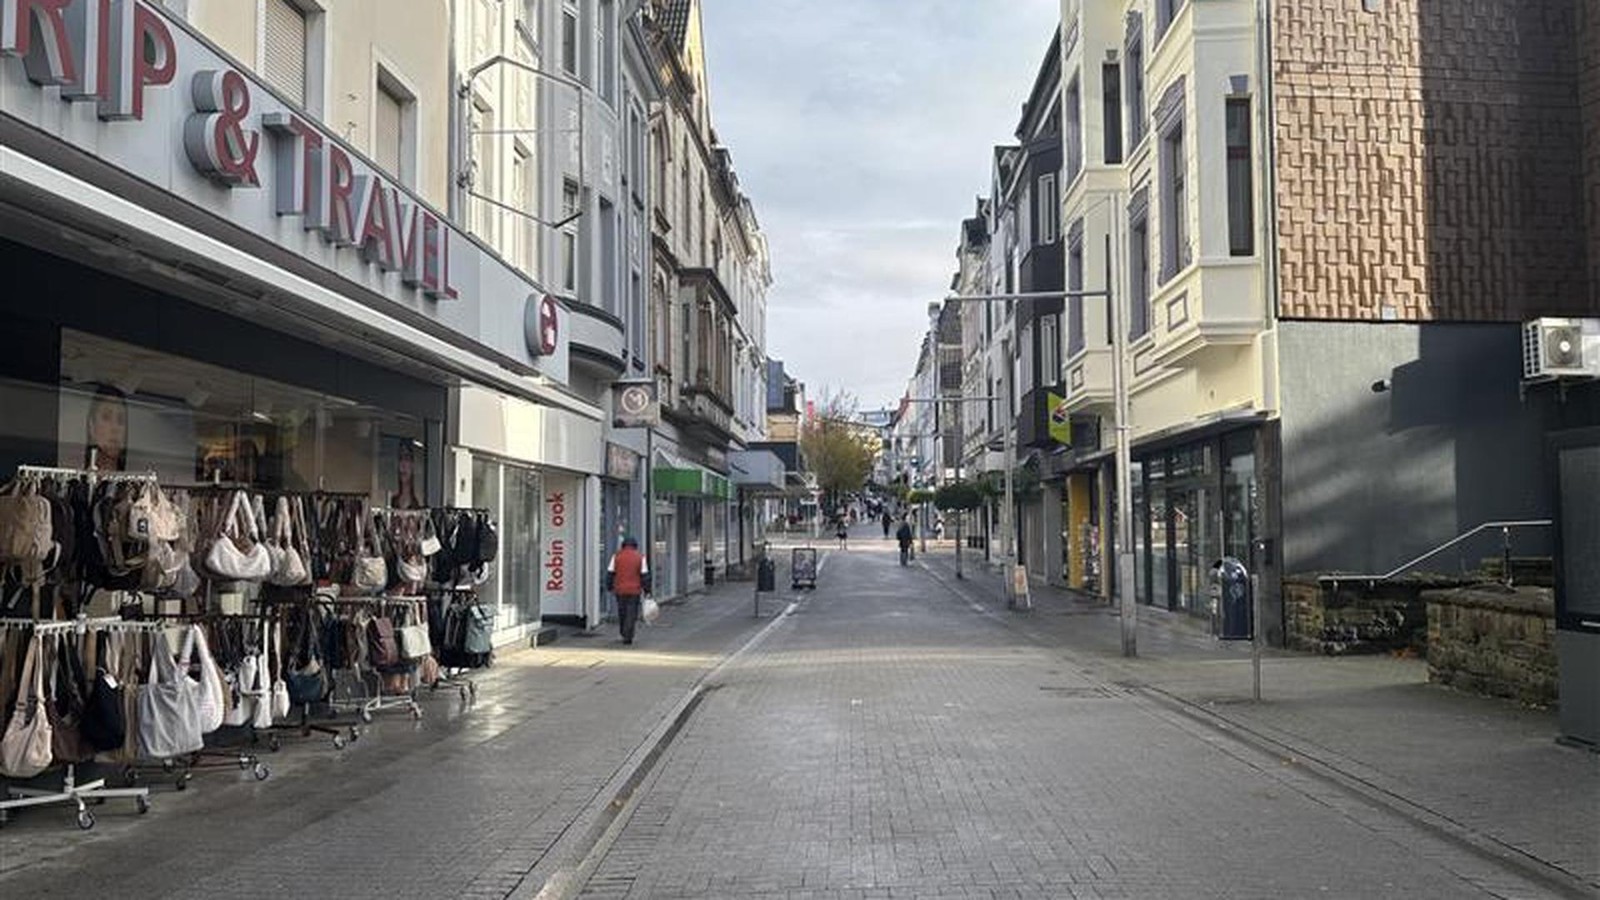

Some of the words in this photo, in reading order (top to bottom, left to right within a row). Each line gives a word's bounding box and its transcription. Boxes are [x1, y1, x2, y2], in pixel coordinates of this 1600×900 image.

[196, 70, 261, 187] &
[276, 113, 458, 299] TRAVEL
[545, 540, 564, 591] Robin
